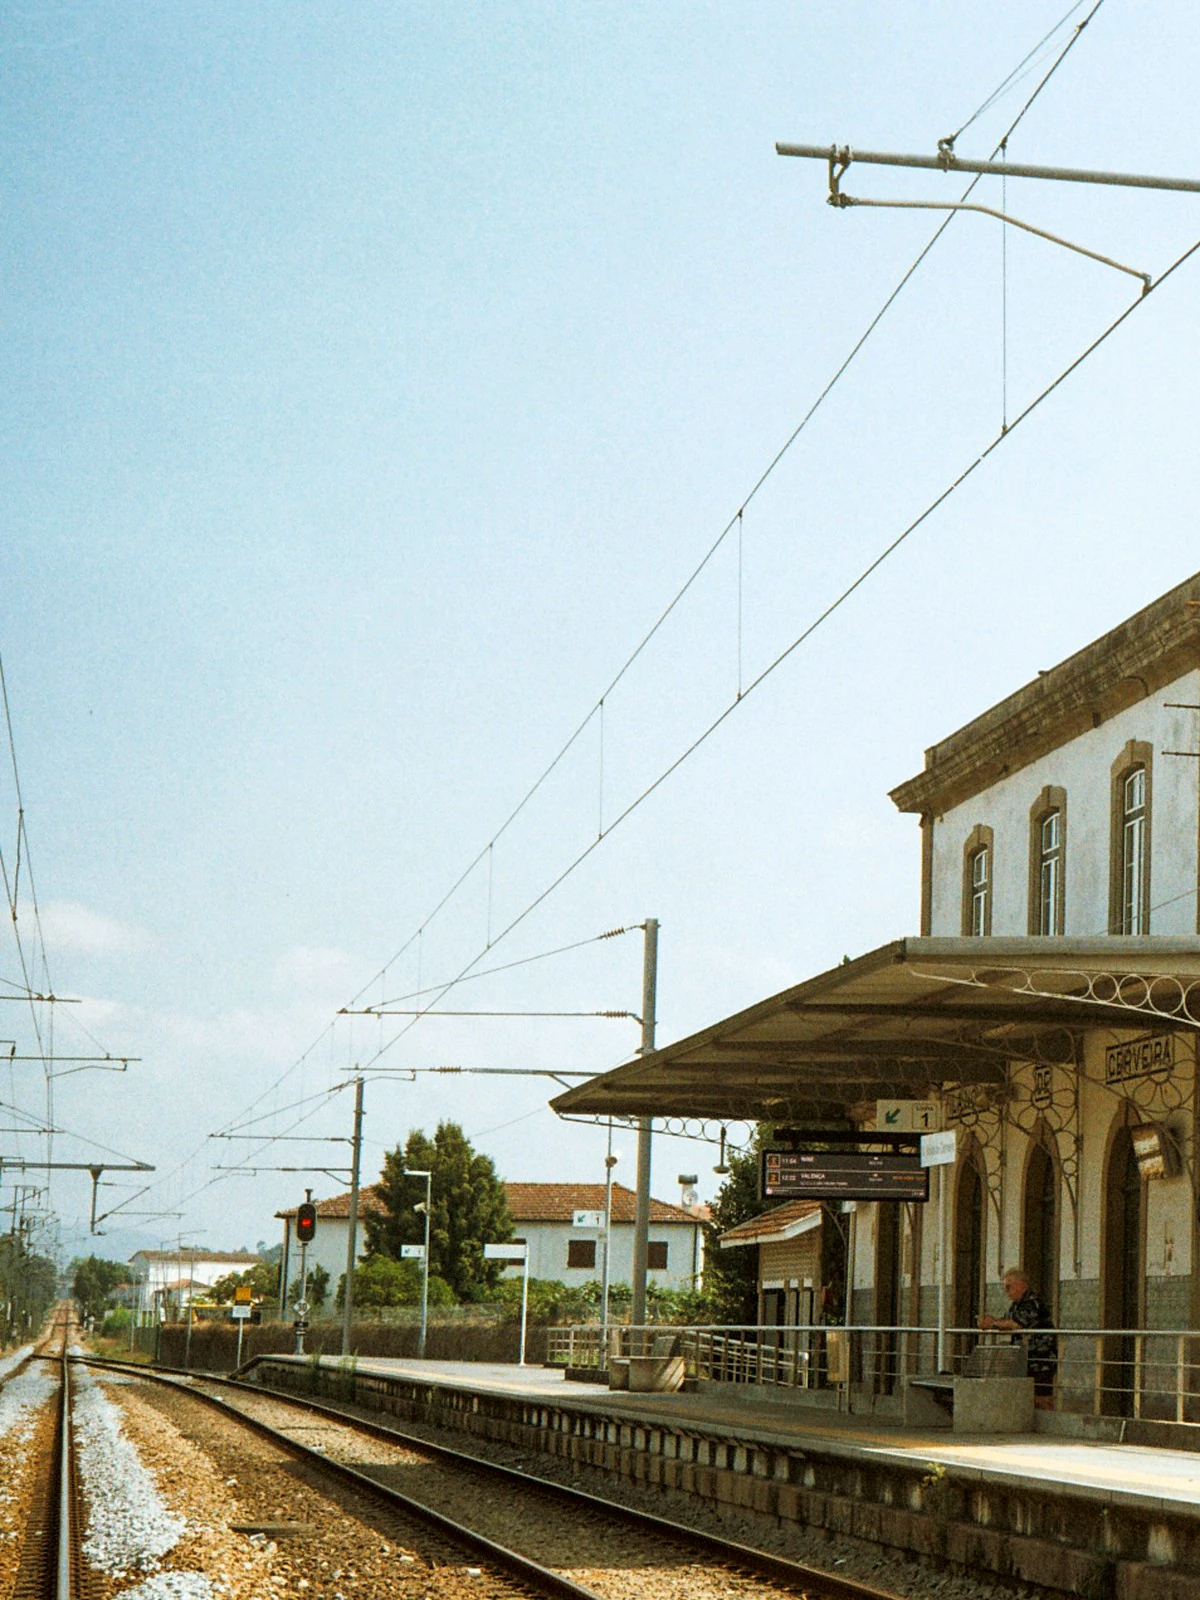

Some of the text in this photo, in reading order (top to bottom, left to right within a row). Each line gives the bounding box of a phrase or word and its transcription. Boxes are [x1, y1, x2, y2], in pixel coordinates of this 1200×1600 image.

[1108, 1040, 1173, 1079] CERVEIRA
[921, 1112, 929, 1128] 1
[800, 1172, 826, 1180] VALENÇA
